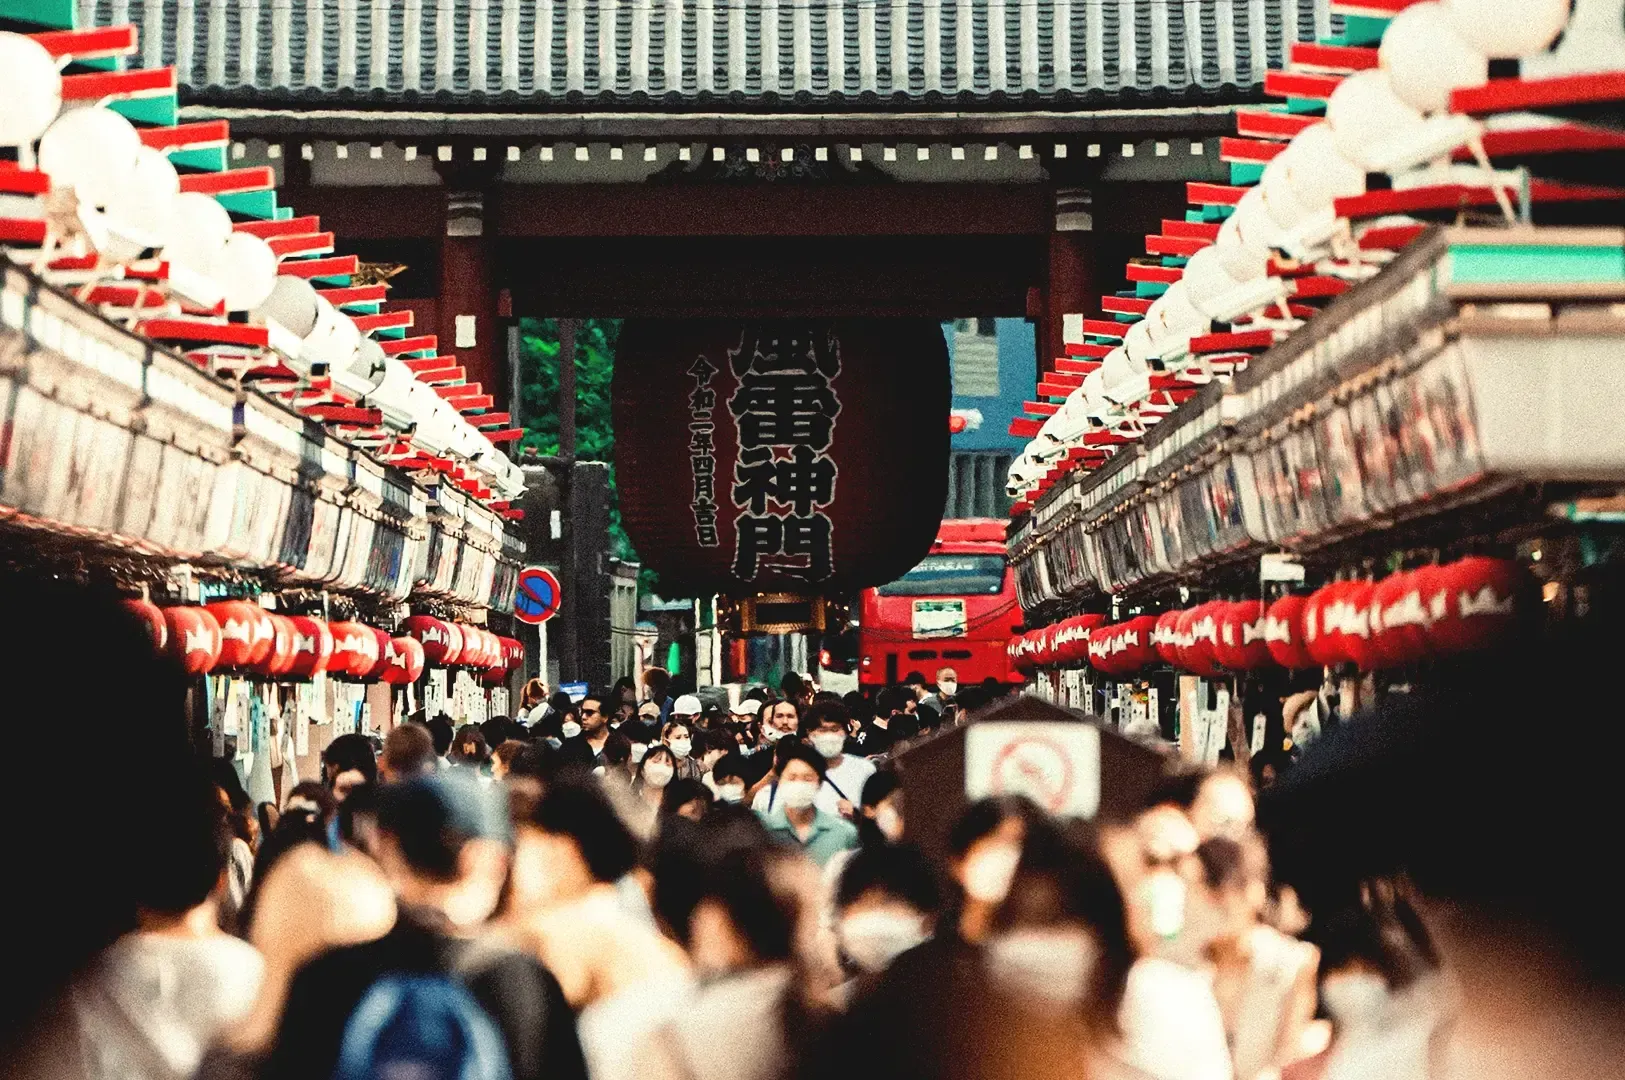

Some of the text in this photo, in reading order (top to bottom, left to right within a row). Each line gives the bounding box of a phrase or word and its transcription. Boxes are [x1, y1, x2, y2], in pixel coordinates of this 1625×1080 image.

[687, 355, 720, 547] 令和二年四月吉日
